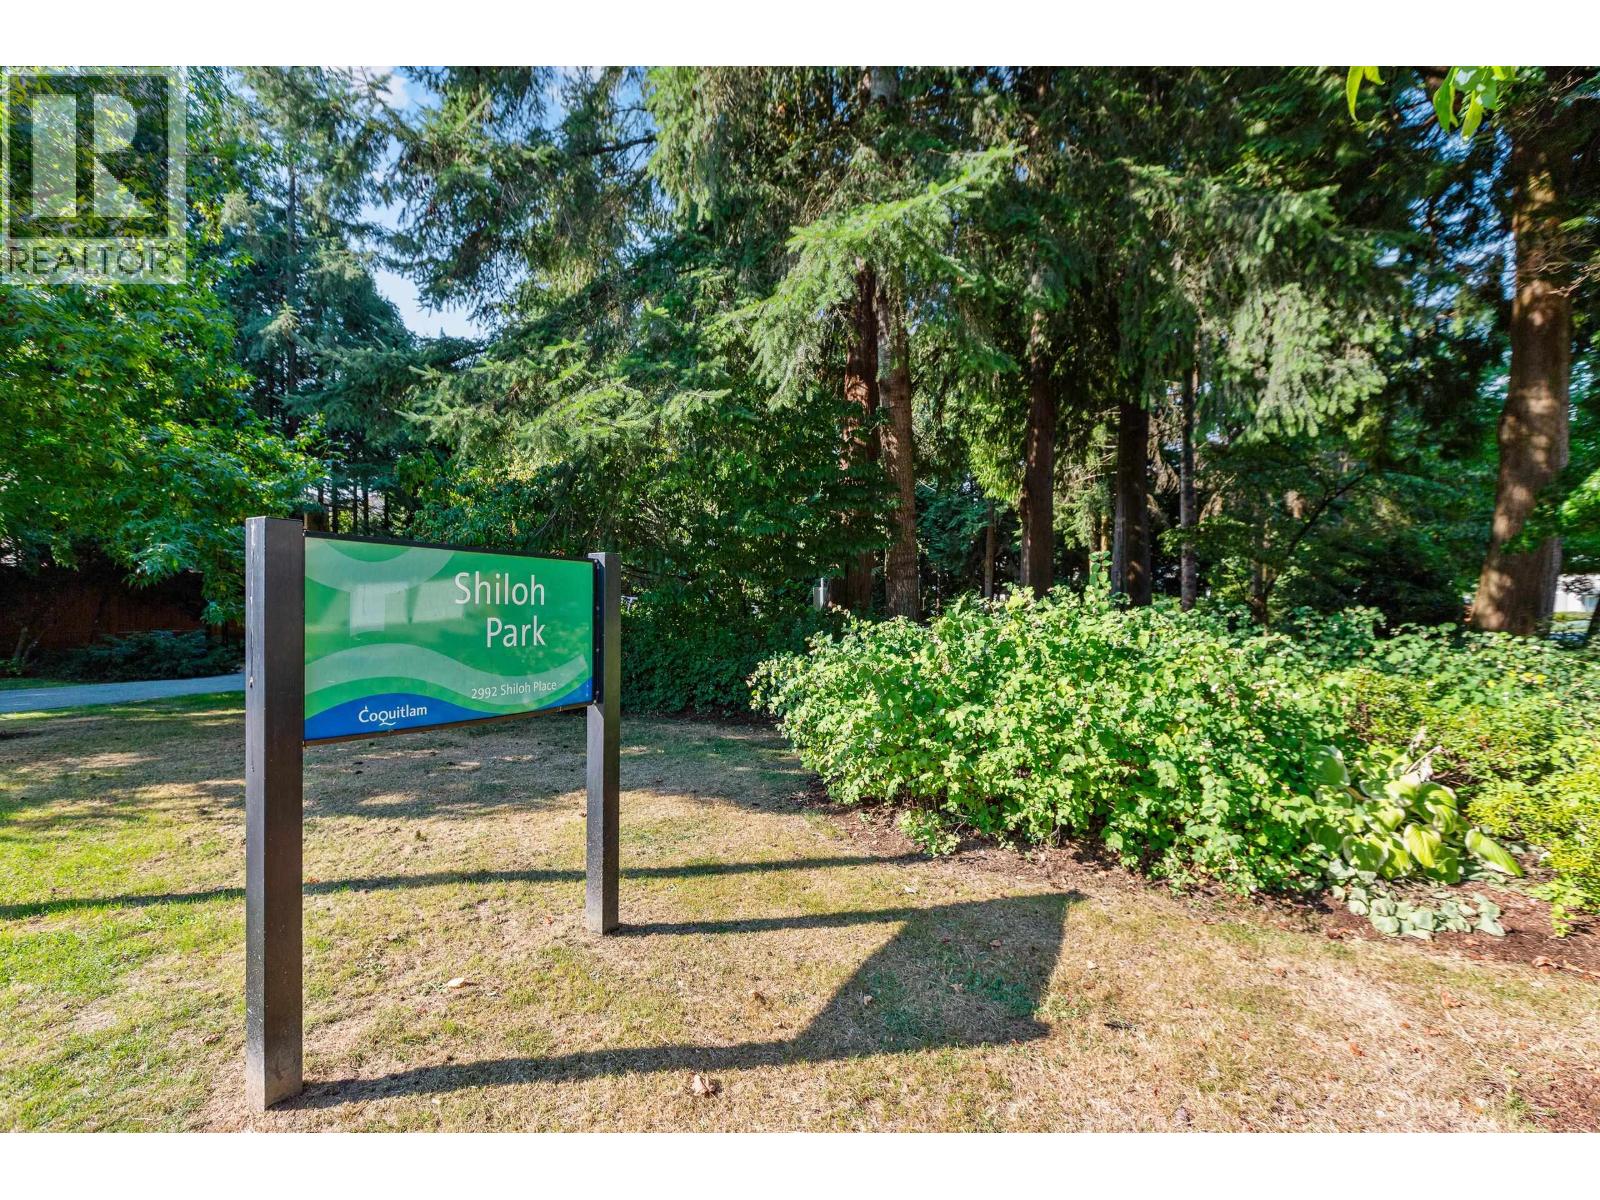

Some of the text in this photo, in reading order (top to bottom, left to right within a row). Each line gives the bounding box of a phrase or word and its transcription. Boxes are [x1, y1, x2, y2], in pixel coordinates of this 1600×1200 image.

[454, 571, 545, 606] Shiloh
[486, 615, 546, 648] Park
[471, 681, 557, 700] 2992 Shiloh Place
